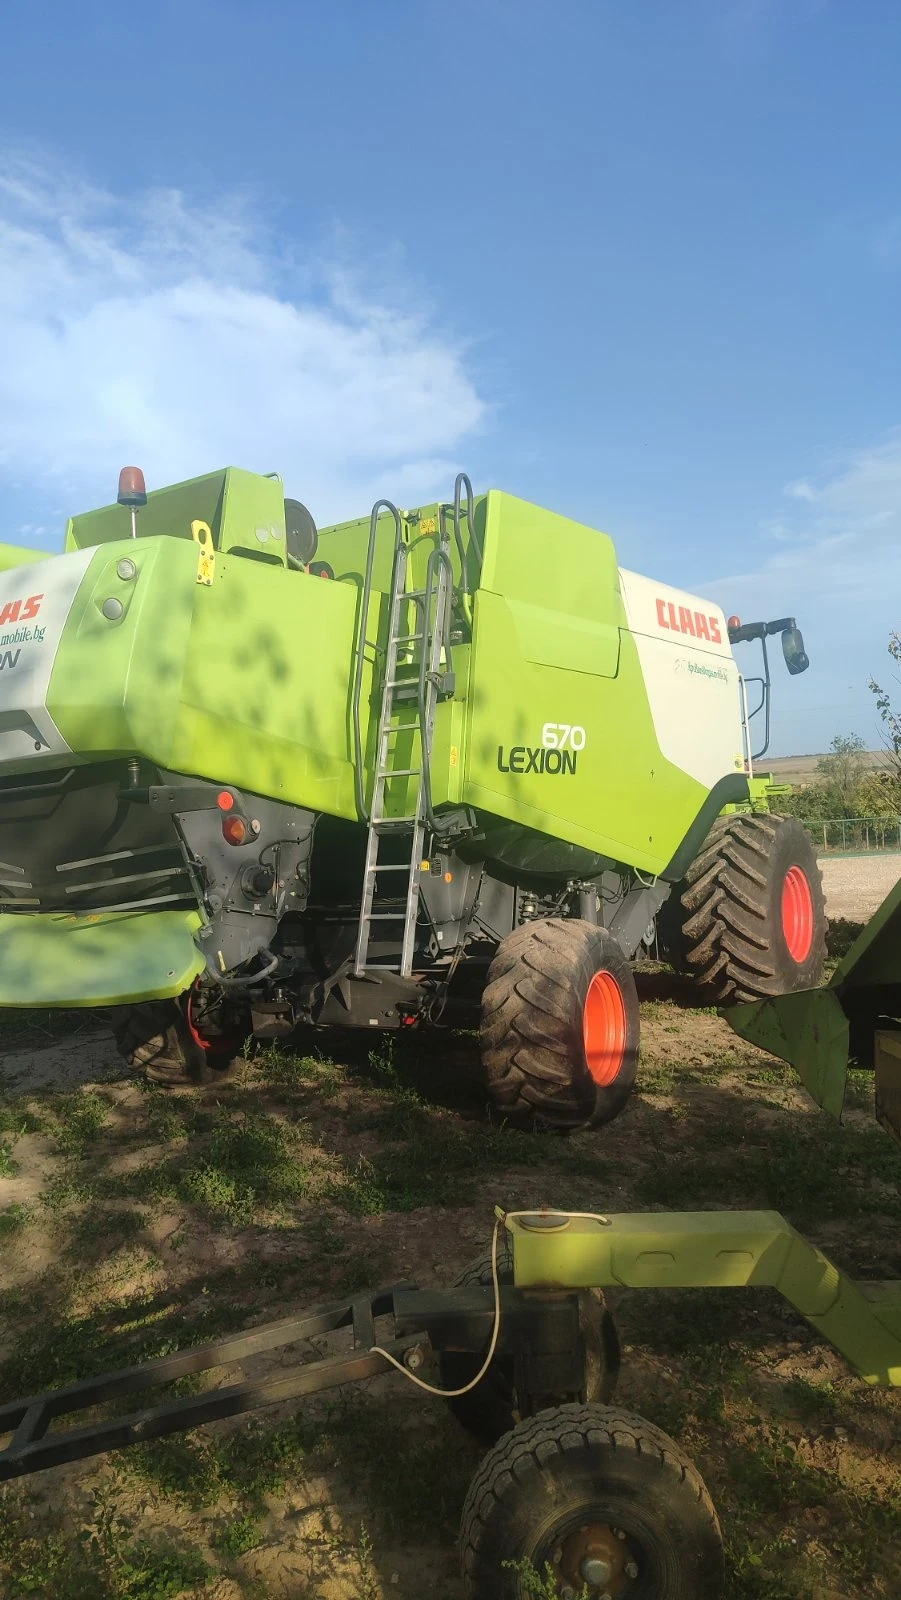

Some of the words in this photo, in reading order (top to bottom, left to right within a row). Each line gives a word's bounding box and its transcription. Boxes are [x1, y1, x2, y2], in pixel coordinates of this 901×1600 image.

[0, 625, 46, 646] mobile.bg
[656, 598, 722, 644] CLAAS
[542, 722, 586, 750] 670
[497, 745, 577, 775] LEXION
